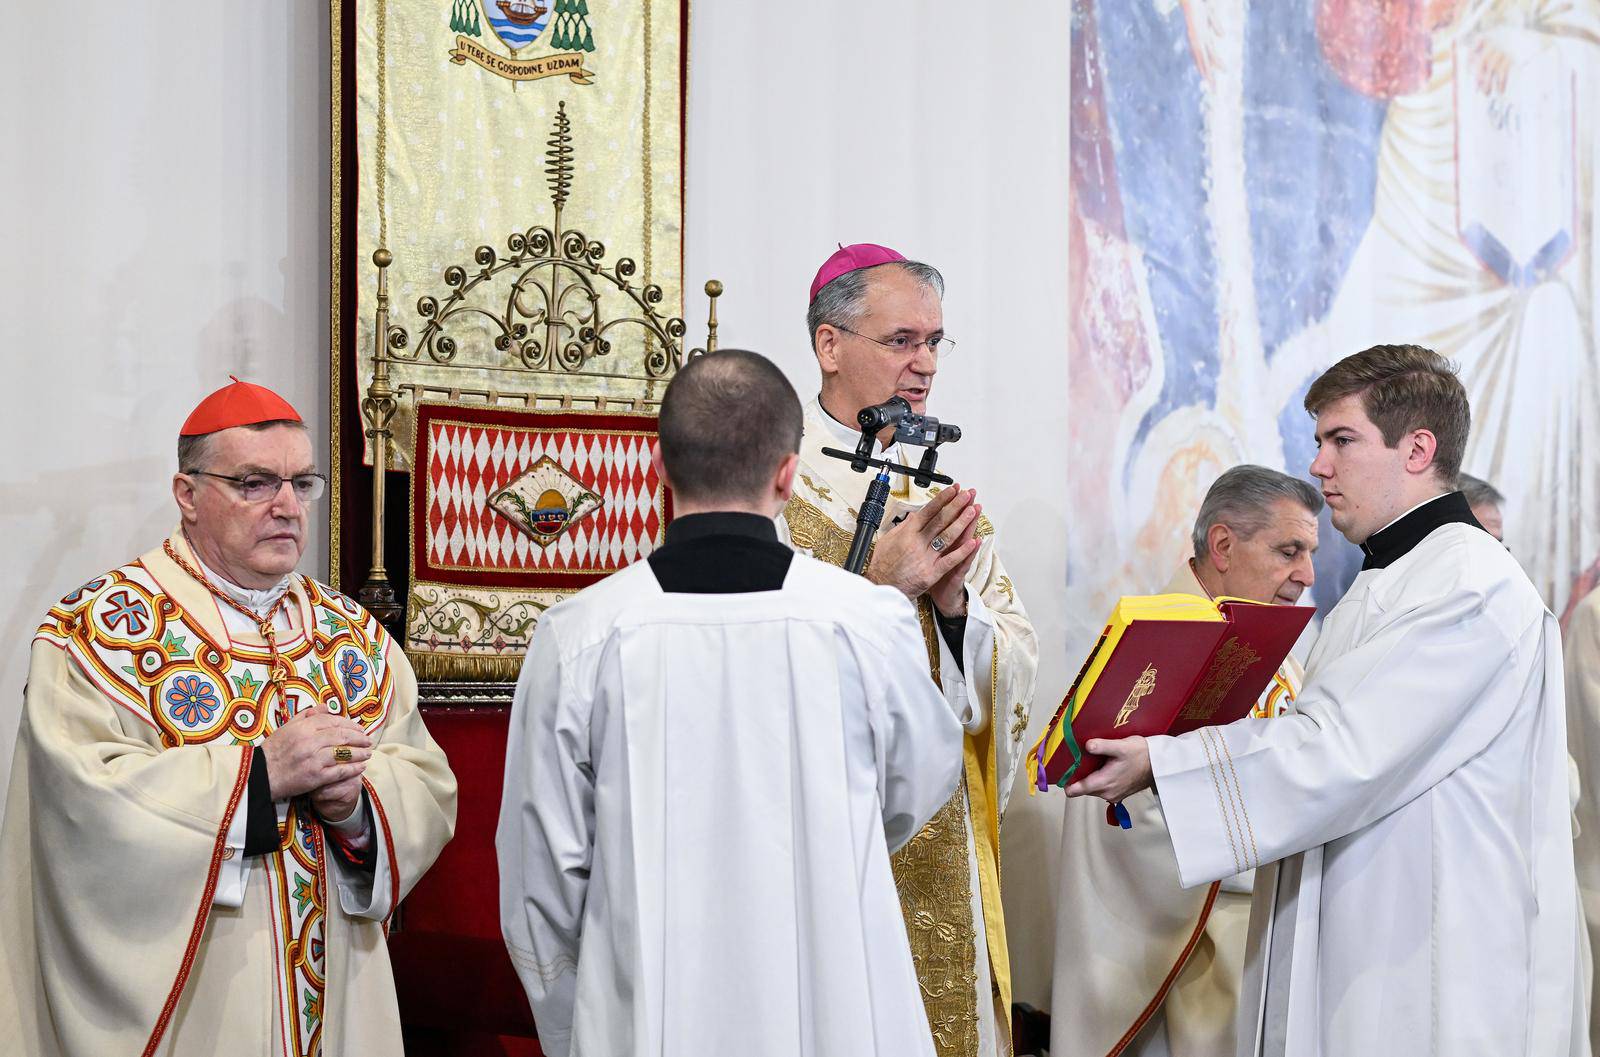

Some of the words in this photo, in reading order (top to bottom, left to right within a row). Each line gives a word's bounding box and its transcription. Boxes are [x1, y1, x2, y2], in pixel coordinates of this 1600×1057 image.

[460, 41, 466, 50] U
[467, 43, 485, 62] TEBE
[486, 55, 496, 68] SE
[498, 60, 544, 75] GOSPODINE
[547, 58, 580, 70] UZDAM
